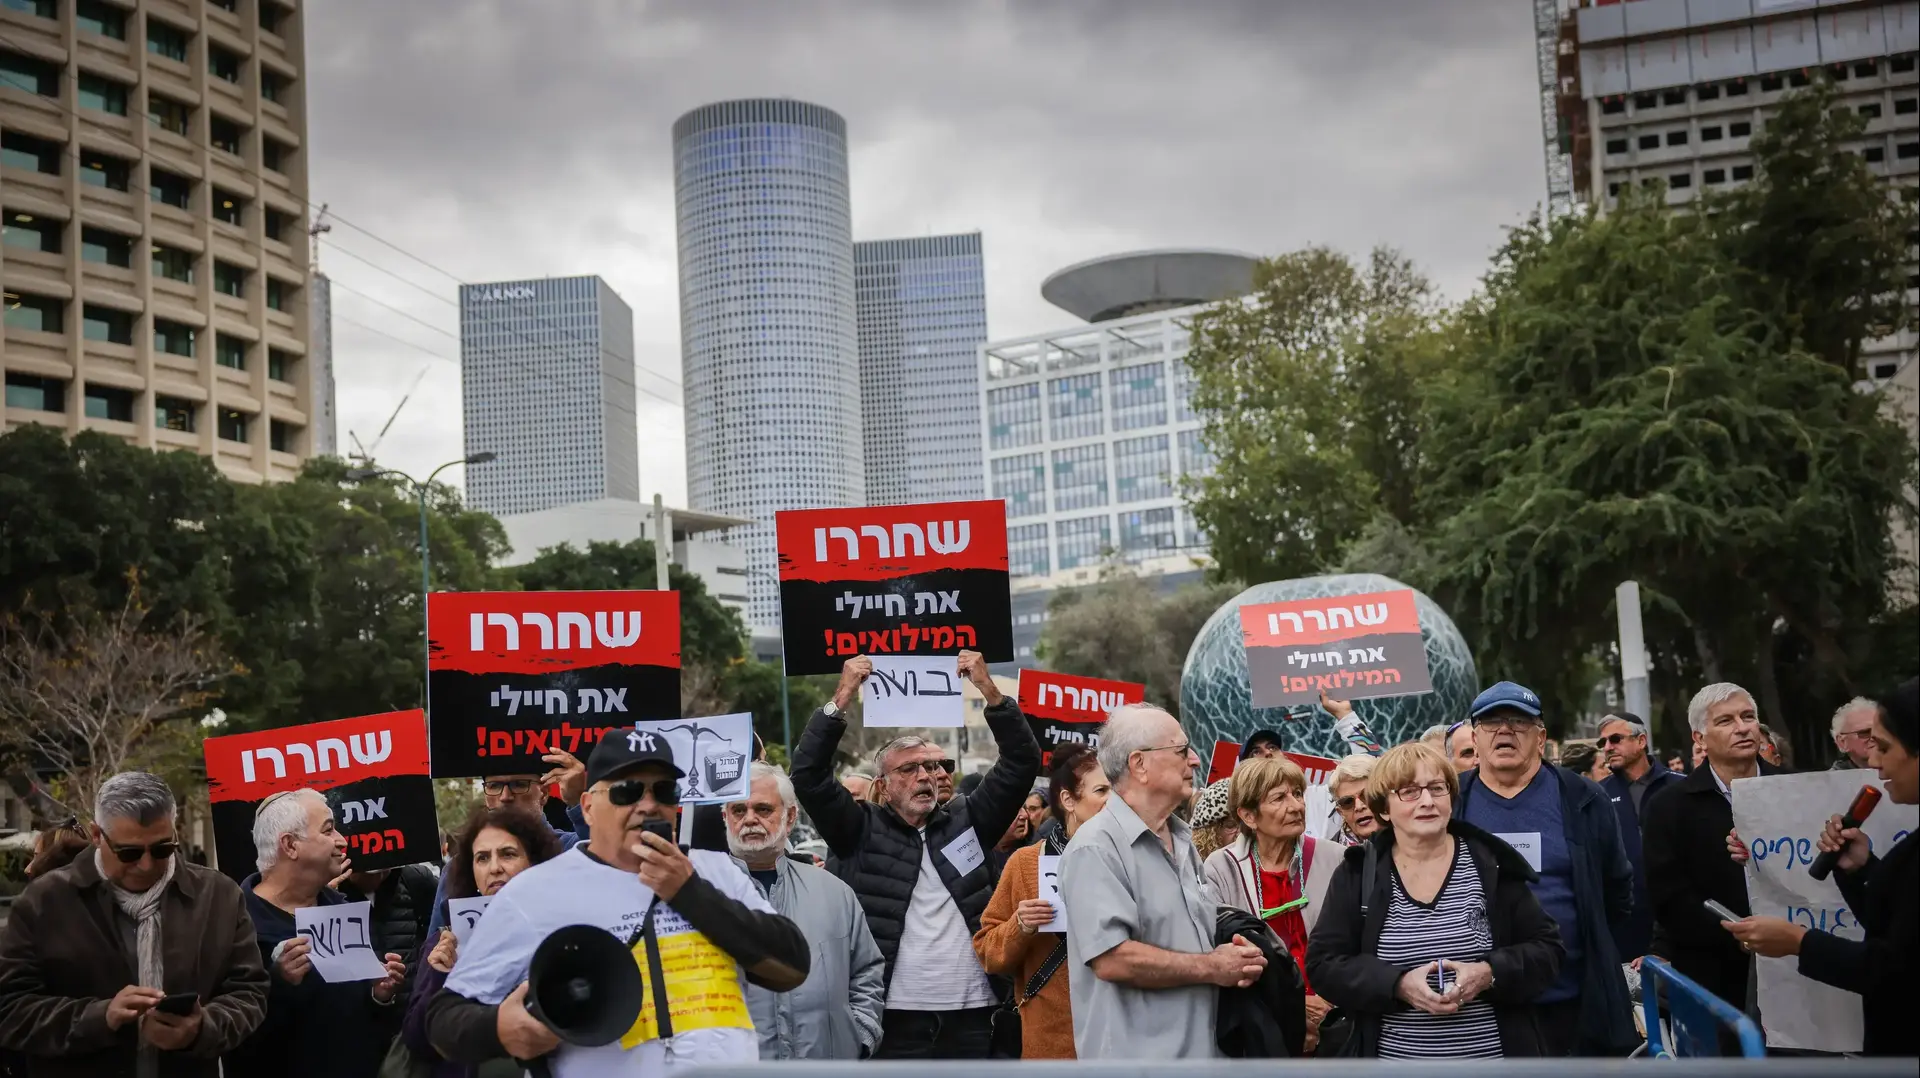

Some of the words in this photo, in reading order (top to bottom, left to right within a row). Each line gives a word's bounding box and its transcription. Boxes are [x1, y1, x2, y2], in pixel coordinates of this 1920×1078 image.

[814, 519, 971, 562] שחררו
[835, 590, 906, 619] חיילי
[914, 589, 962, 615] את
[470, 611, 641, 652] שחררו
[1268, 602, 1389, 636] שחררו
[824, 622, 977, 657] המילואים!
[1287, 650, 1344, 669] חיילי
[1348, 646, 1387, 665] את
[1280, 668, 1401, 694] המילואים!
[490, 684, 568, 716] חיילי
[577, 687, 628, 714] את
[1038, 682, 1125, 713] שחררו
[1044, 725, 1084, 745] חיילי
[241, 730, 393, 783] שחררו
[341, 796, 389, 825] את
